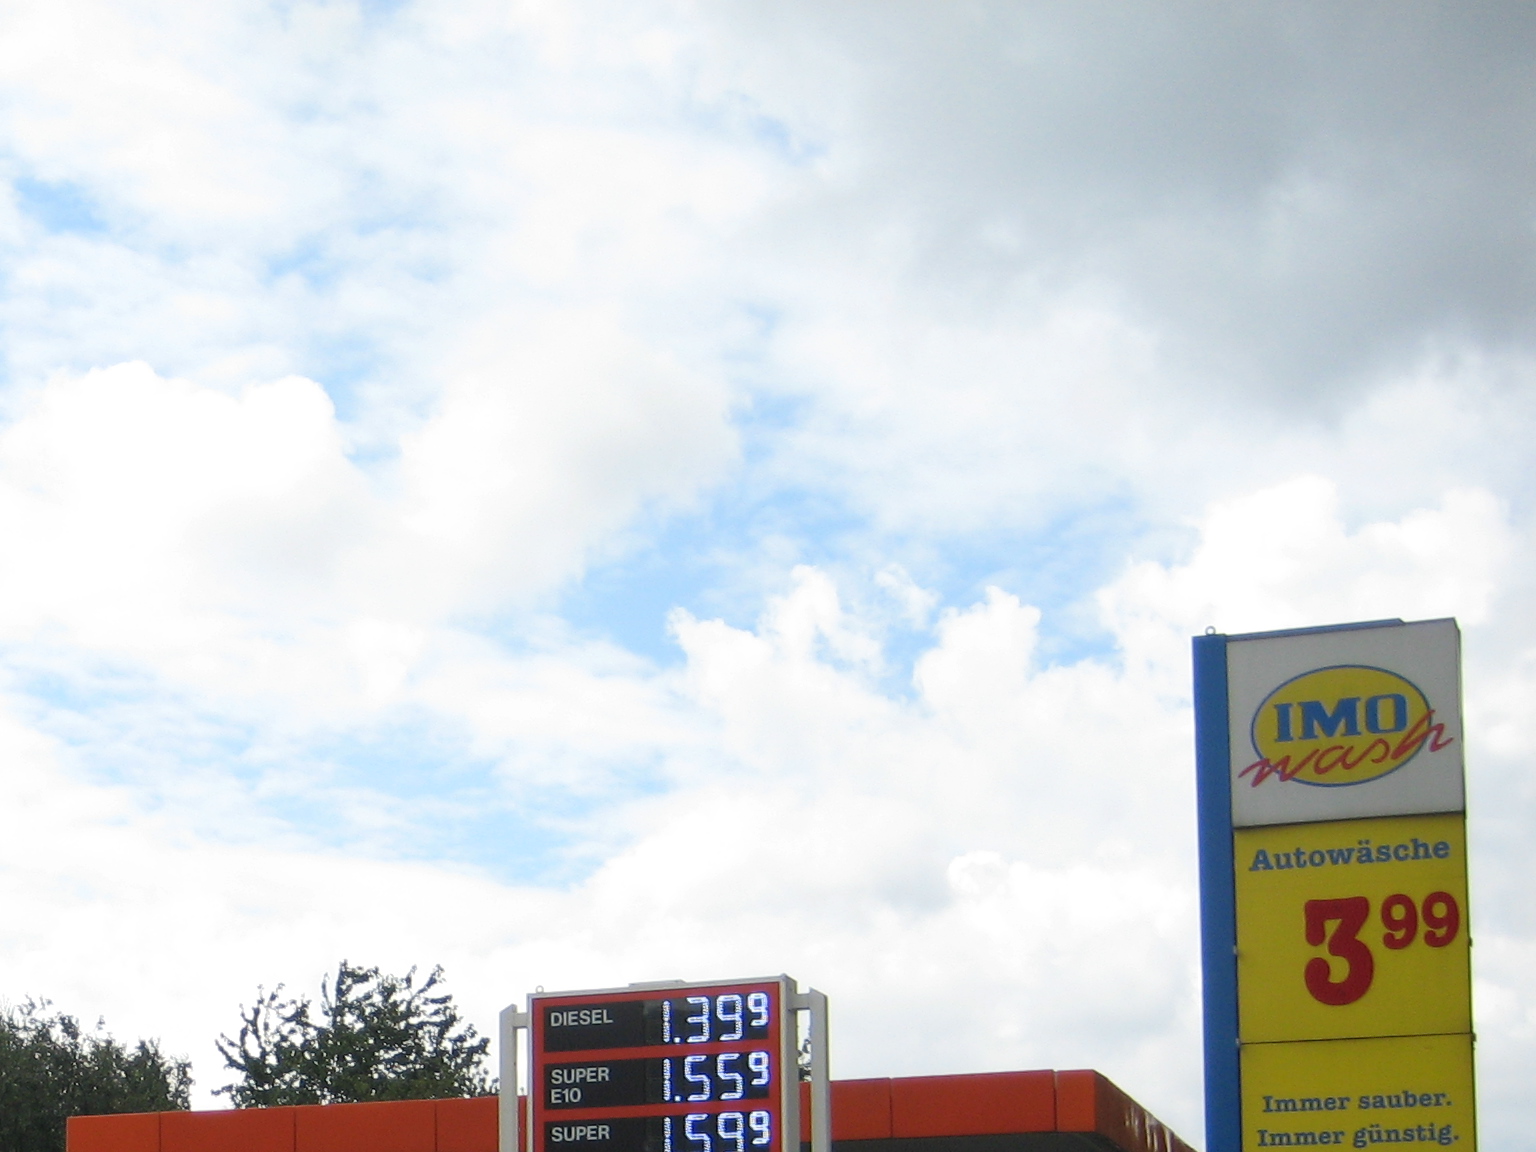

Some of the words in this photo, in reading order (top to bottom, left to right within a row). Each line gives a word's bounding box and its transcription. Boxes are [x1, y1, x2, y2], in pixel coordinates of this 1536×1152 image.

[1274, 694, 1407, 742] IMO
[1237, 709, 1454, 787] wash
[1249, 838, 1451, 872] Autowäsche
[550, 1009, 613, 1026] DIESEL
[662, 992, 768, 1043] 1.399
[551, 1067, 610, 1084] SUPER
[662, 1051, 769, 1102] 1.559
[551, 1088, 581, 1104] E10
[1263, 1095, 1350, 1113] Immer
[1358, 1091, 1452, 1110] sauber.
[551, 1125, 610, 1142] SUPER
[1258, 1129, 1345, 1147] Immer
[1353, 1123, 1459, 1148] günstig.
